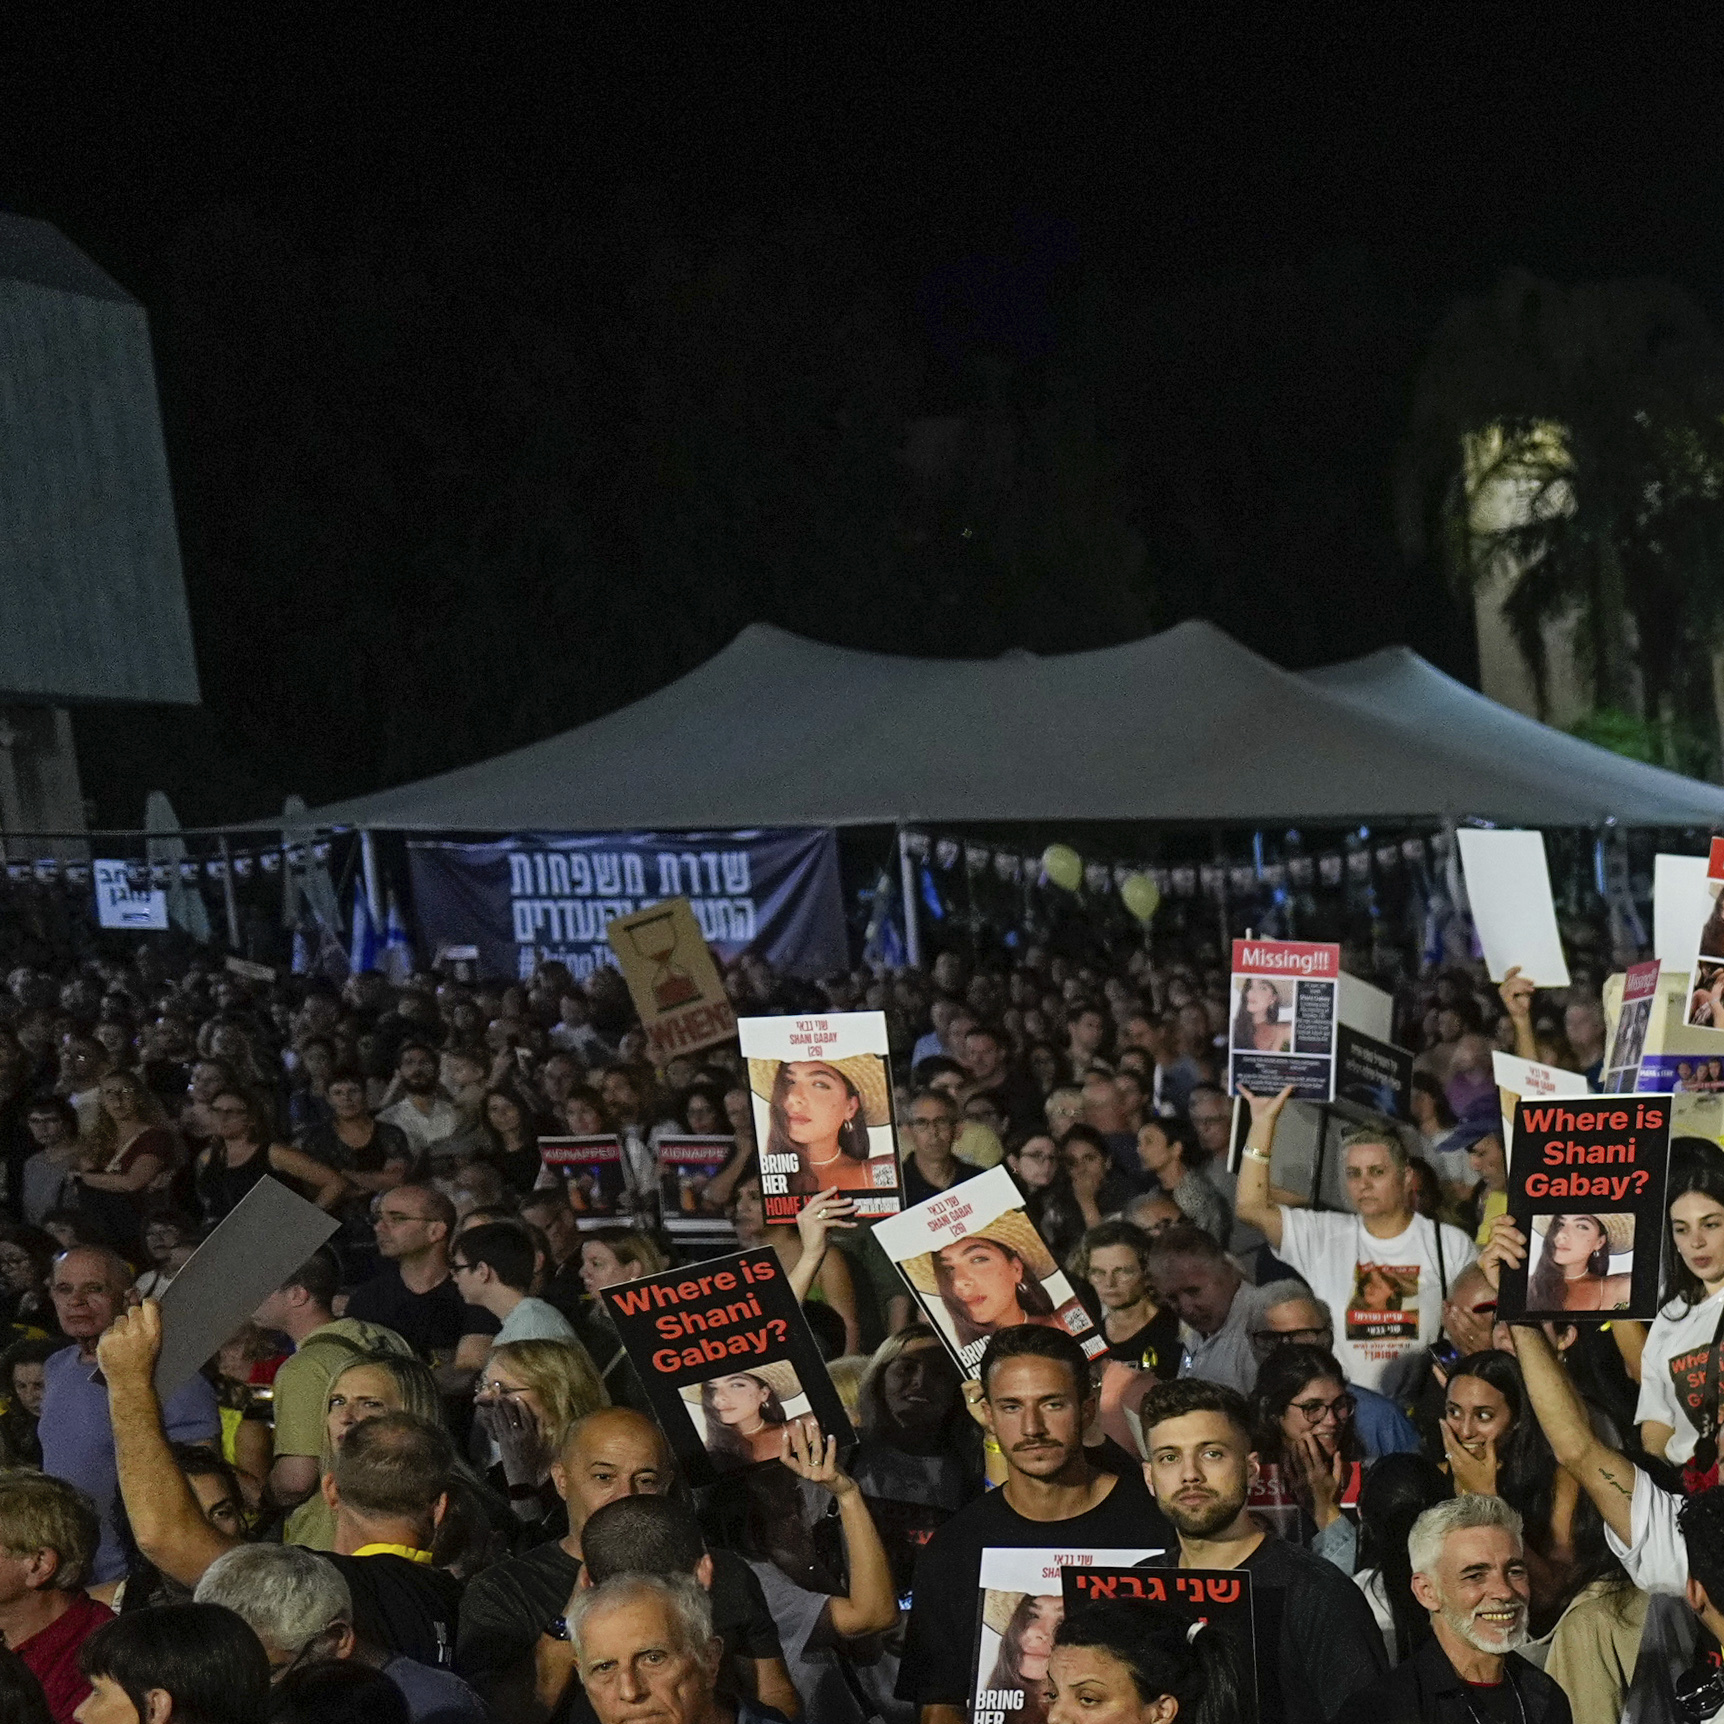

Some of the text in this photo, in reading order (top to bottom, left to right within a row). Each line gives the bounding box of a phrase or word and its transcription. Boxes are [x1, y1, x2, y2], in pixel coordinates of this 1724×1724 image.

[508, 851, 750, 896] שדרת משפחות
[1242, 946, 1331, 974] Missing!!!
[789, 1032, 838, 1046] SHANI GABAY
[1522, 1103, 1664, 1134] Where is
[760, 1153, 800, 1174] BRING
[1542, 1137, 1637, 1166] Shani
[762, 1175, 789, 1195] HER
[1524, 1169, 1650, 1201] Gabay?
[765, 1197, 801, 1216] HOME
[927, 1203, 974, 1233] SHANI GABAY
[612, 1259, 776, 1317] Where is
[655, 1292, 763, 1340] Shani
[652, 1318, 788, 1373] Gabay?
[1671, 1350, 1710, 1375] Whe
[1042, 1567, 1061, 1579] SHA
[1053, 1554, 1093, 1566] שני גבאי
[1075, 1575, 1241, 1604] שני גבאי
[974, 1689, 1025, 1710] BRING
